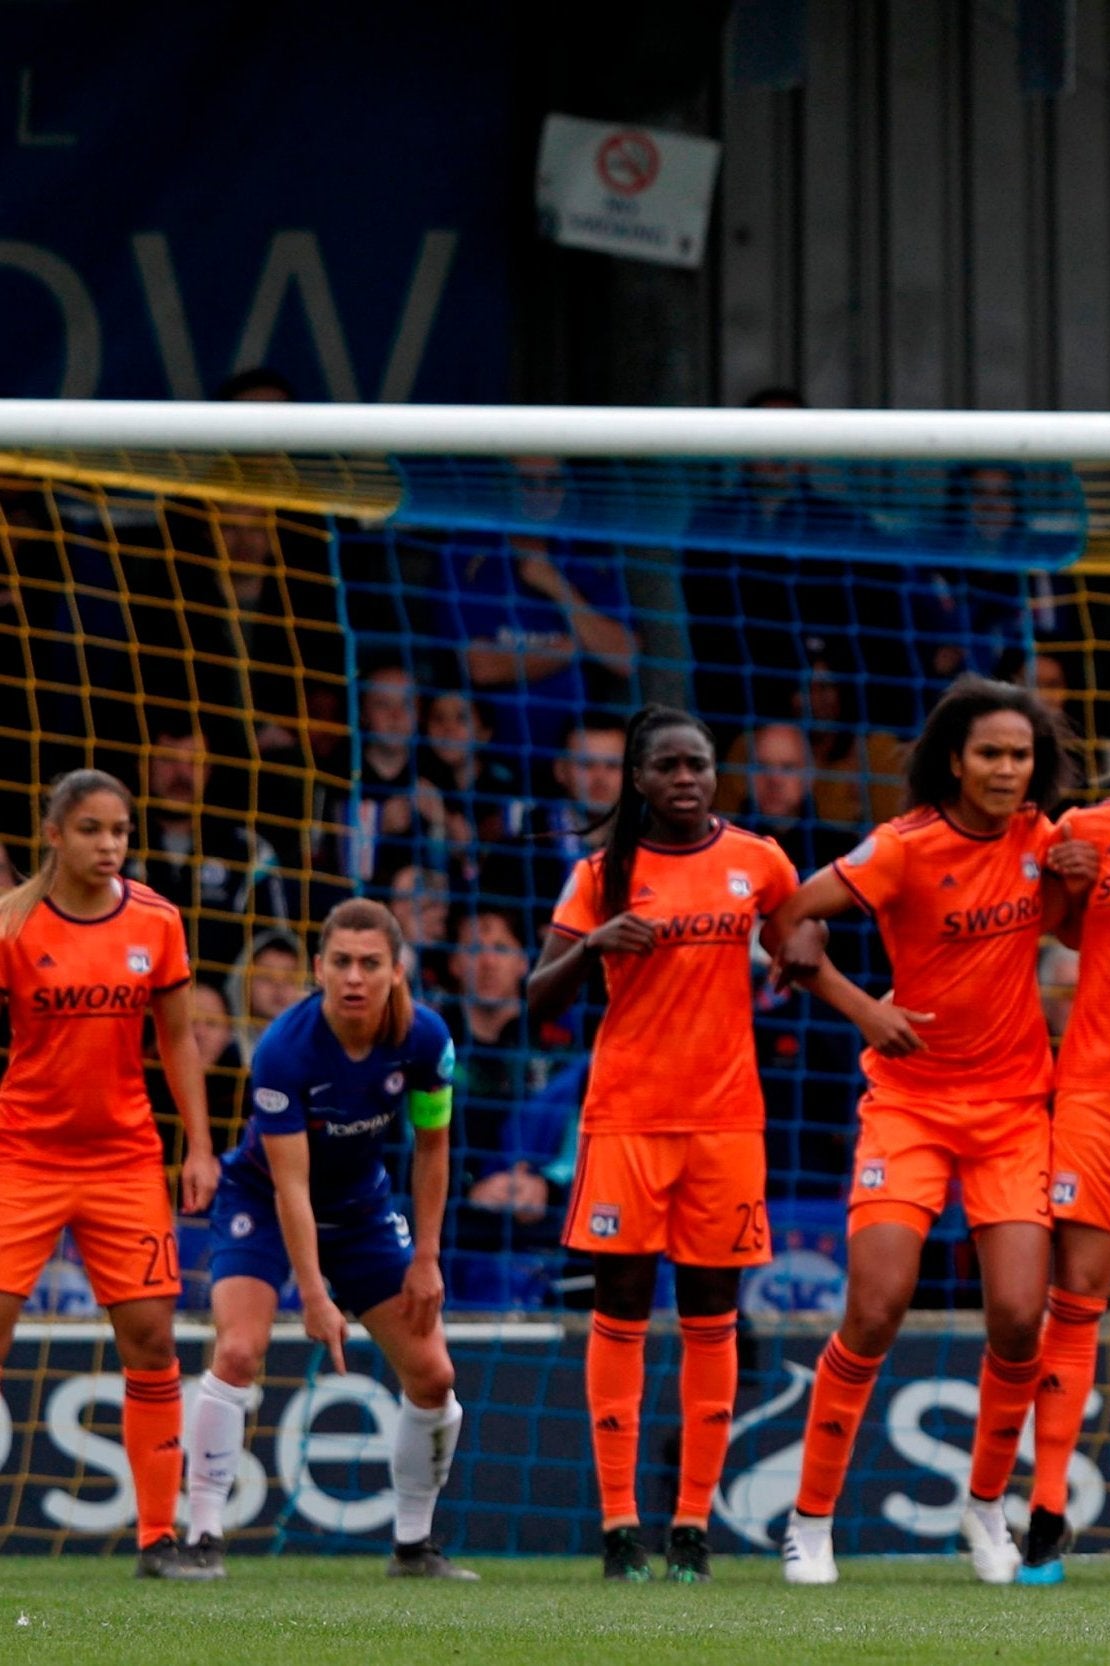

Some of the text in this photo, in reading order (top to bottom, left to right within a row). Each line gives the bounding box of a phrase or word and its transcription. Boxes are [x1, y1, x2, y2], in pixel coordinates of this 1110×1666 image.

[660, 912, 752, 939] WORD
[32, 984, 151, 1012] SWORD
[140, 1232, 178, 1286] 20
